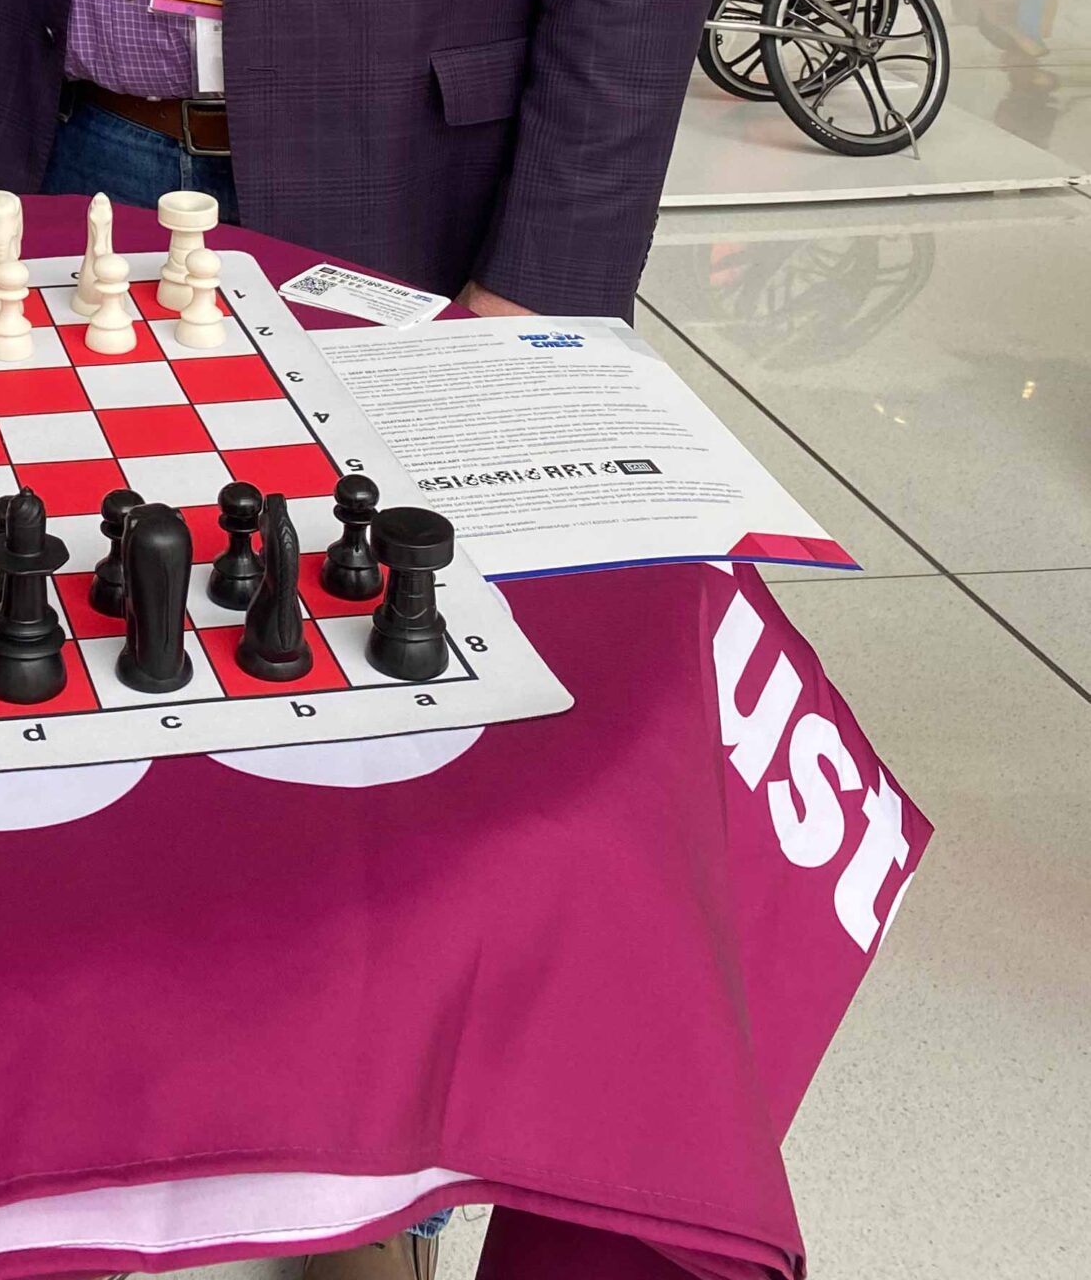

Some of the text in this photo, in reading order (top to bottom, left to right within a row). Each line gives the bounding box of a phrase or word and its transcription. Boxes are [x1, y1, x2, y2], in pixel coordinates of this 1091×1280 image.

[254, 326, 274, 337] 2
[530, 340, 584, 348] CHESS
[285, 371, 304, 383] 3
[313, 412, 330, 424] 4
[345, 458, 364, 472] 5
[464, 635, 488, 653] 8
[22, 723, 47, 742] d
[160, 715, 182, 729] c
[290, 701, 317, 718] b
[414, 693, 437, 707] a
[712, 588, 911, 954] ust
